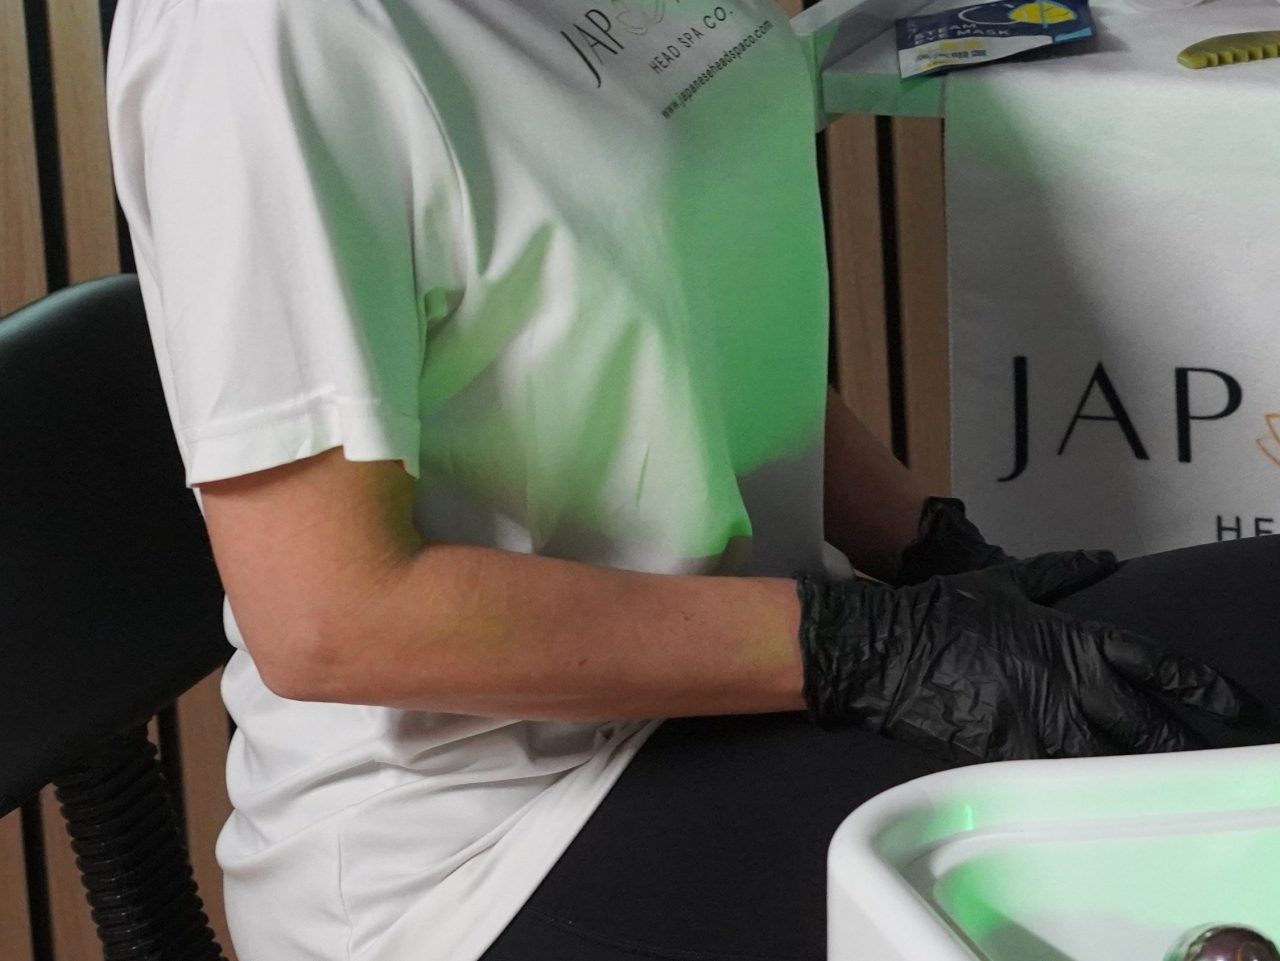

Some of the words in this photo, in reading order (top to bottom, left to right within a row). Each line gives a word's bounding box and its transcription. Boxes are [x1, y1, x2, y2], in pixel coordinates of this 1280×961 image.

[649, 44, 682, 76] HEAD
[677, 26, 705, 49] SPA
[702, 5, 735, 30] CO.
[956, 28, 1009, 37] MASK
